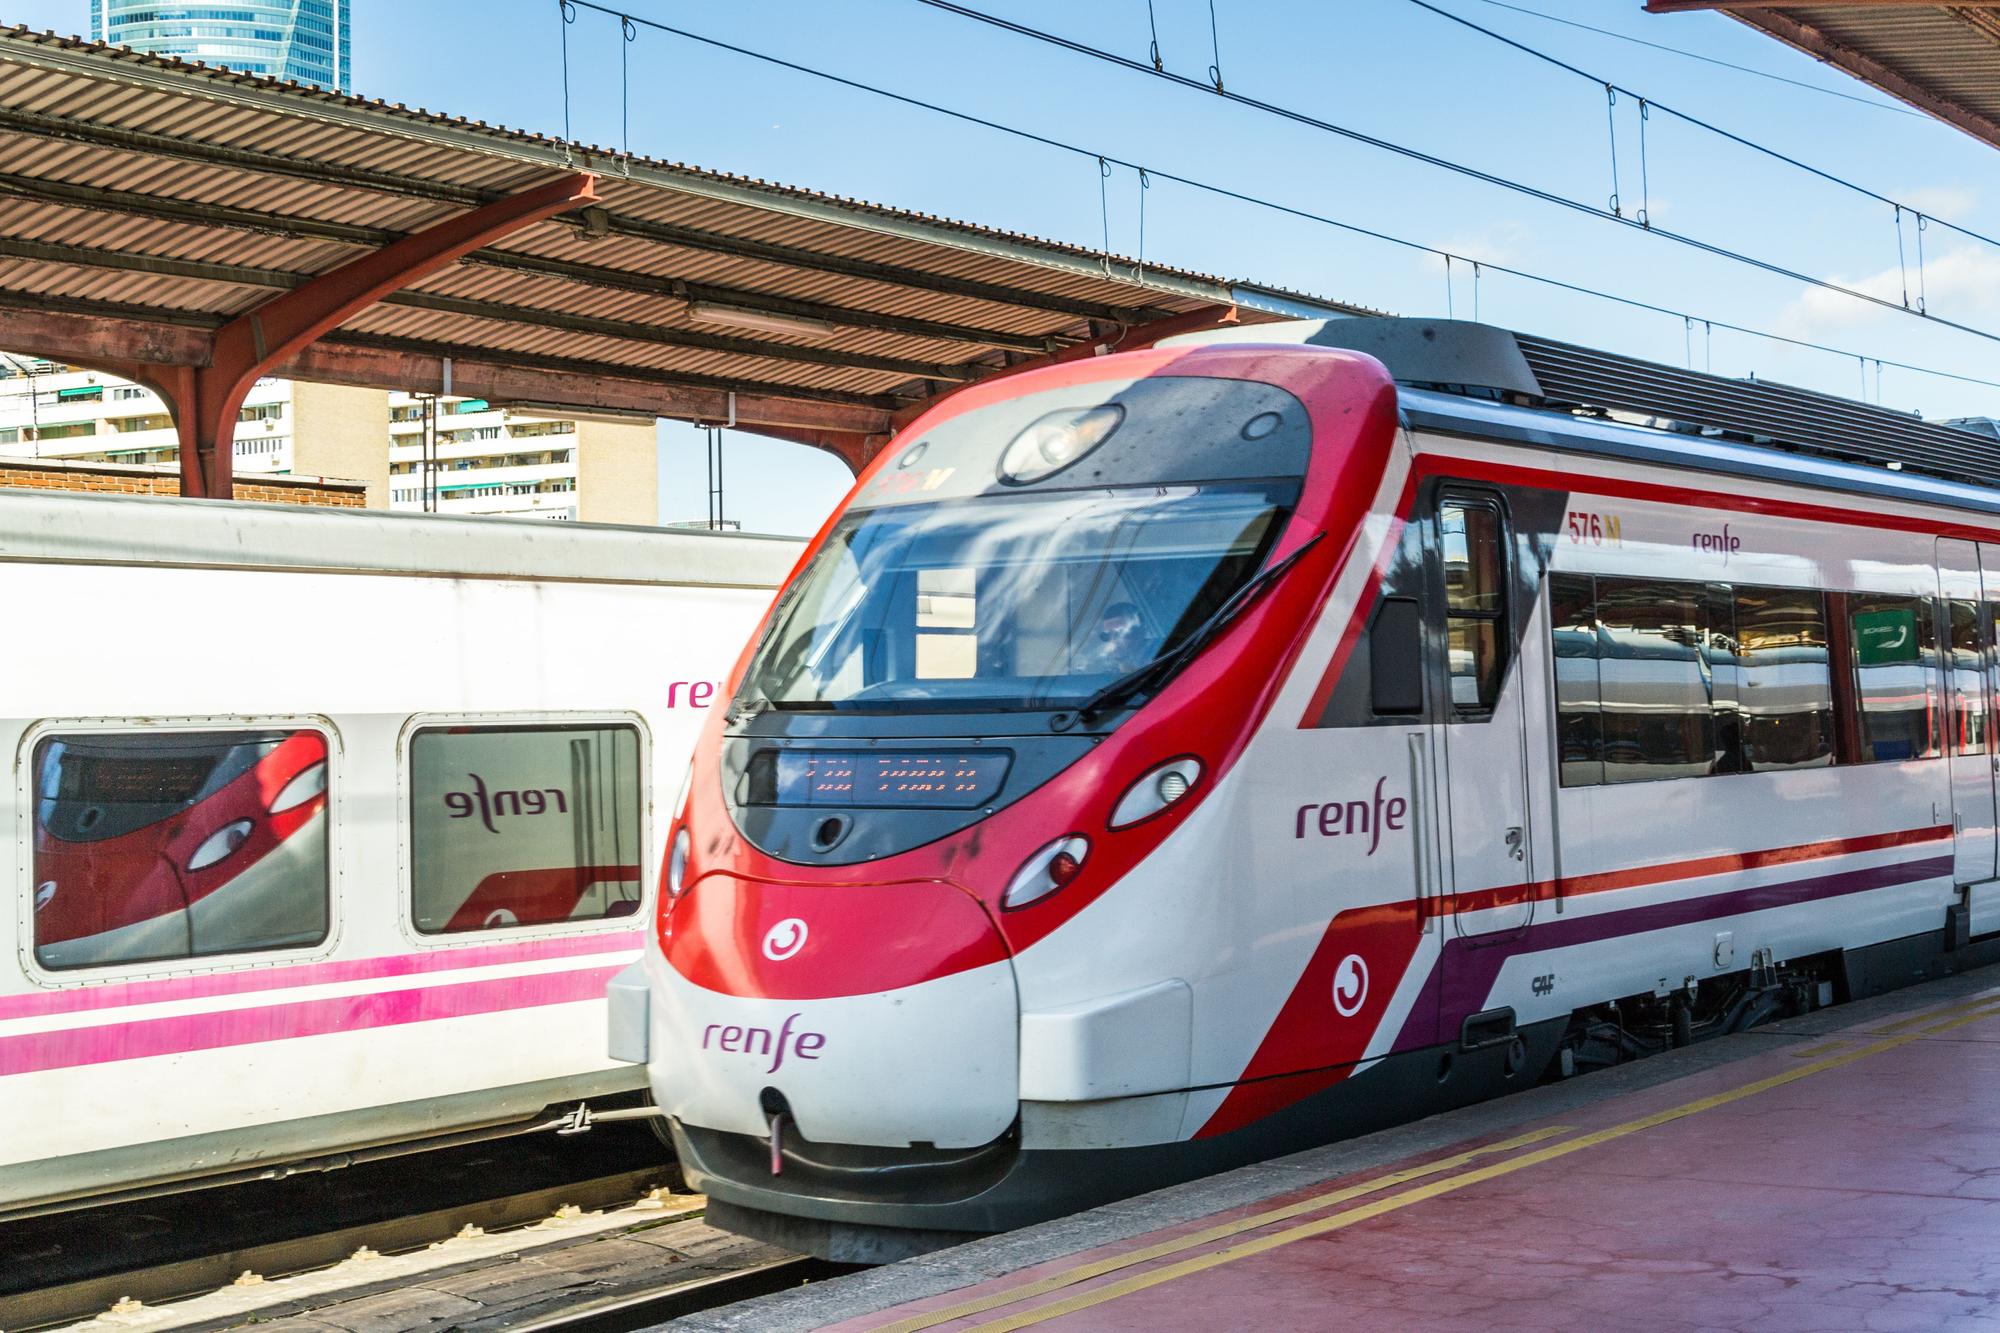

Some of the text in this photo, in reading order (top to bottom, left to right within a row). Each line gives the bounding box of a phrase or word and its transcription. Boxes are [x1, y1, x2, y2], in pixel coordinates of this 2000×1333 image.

[1692, 523, 1741, 568] renfe
[667, 681, 723, 708] re
[1295, 775, 1407, 856] renfe
[702, 1012, 827, 1074] renfe
